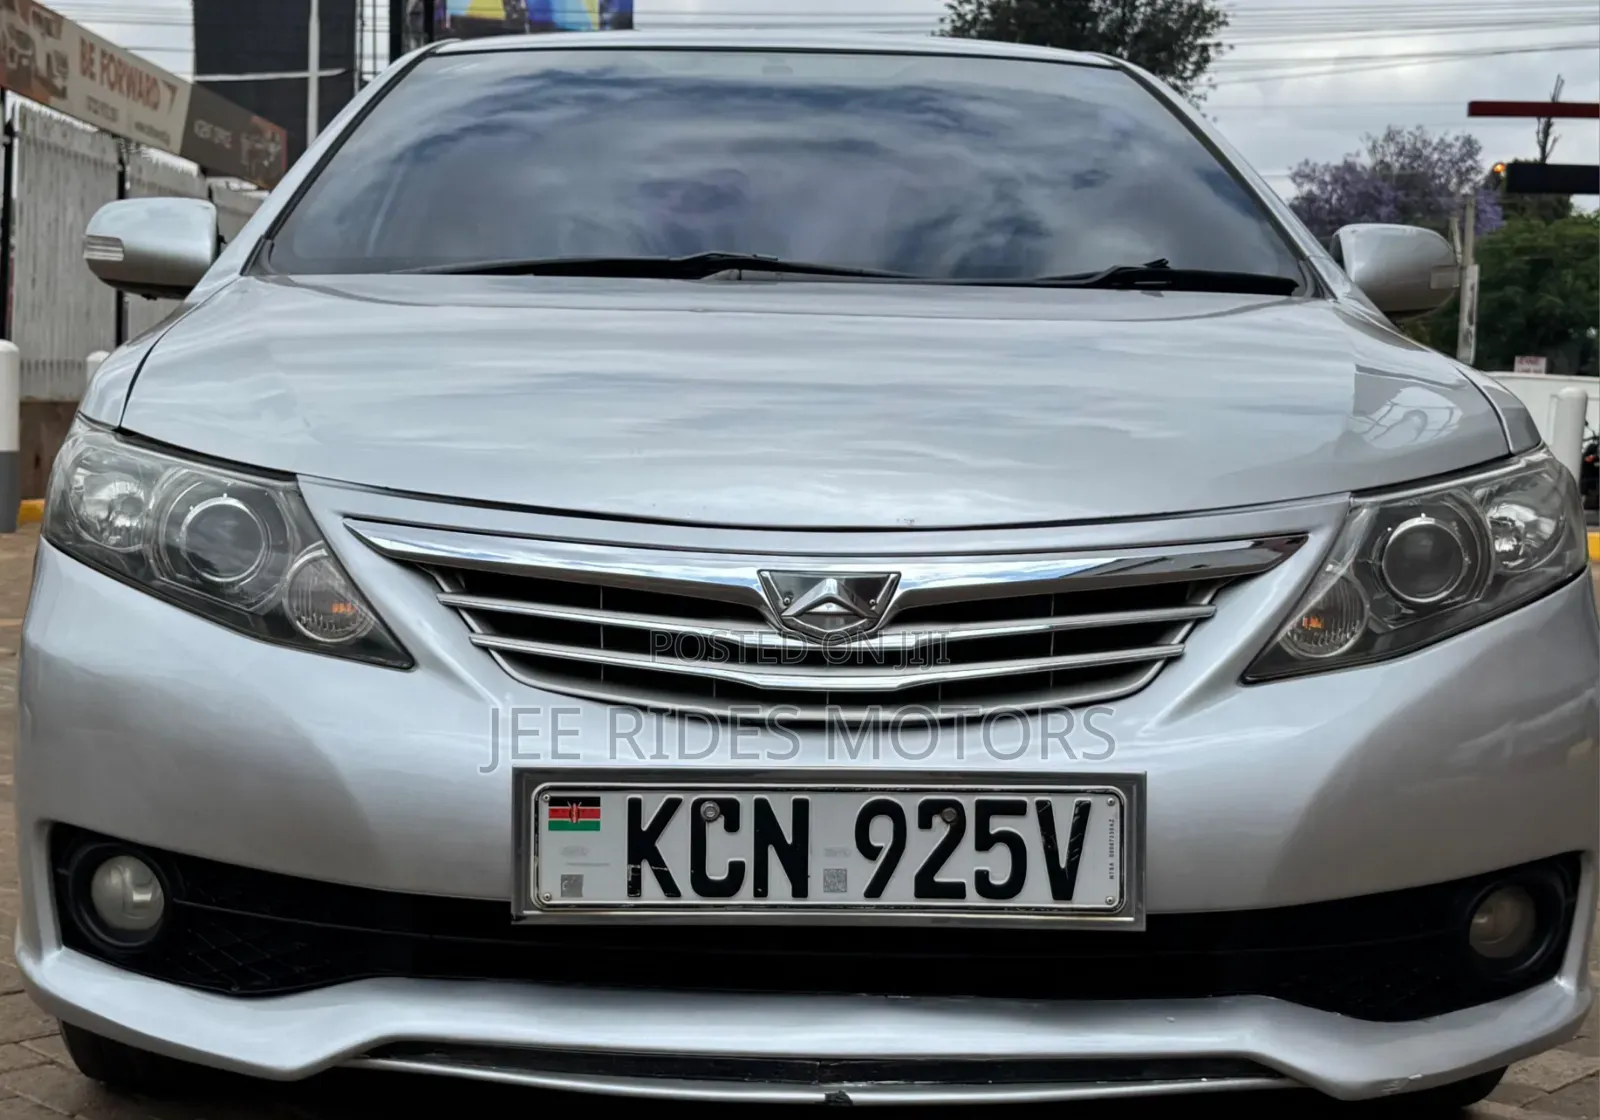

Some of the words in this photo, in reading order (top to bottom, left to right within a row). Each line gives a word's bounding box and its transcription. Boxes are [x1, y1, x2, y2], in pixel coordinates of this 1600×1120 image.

[80, 36, 96, 81] BE
[100, 48, 161, 110] FORWARD
[626, 796, 810, 899] KCN
[854, 796, 1092, 901] 925V
